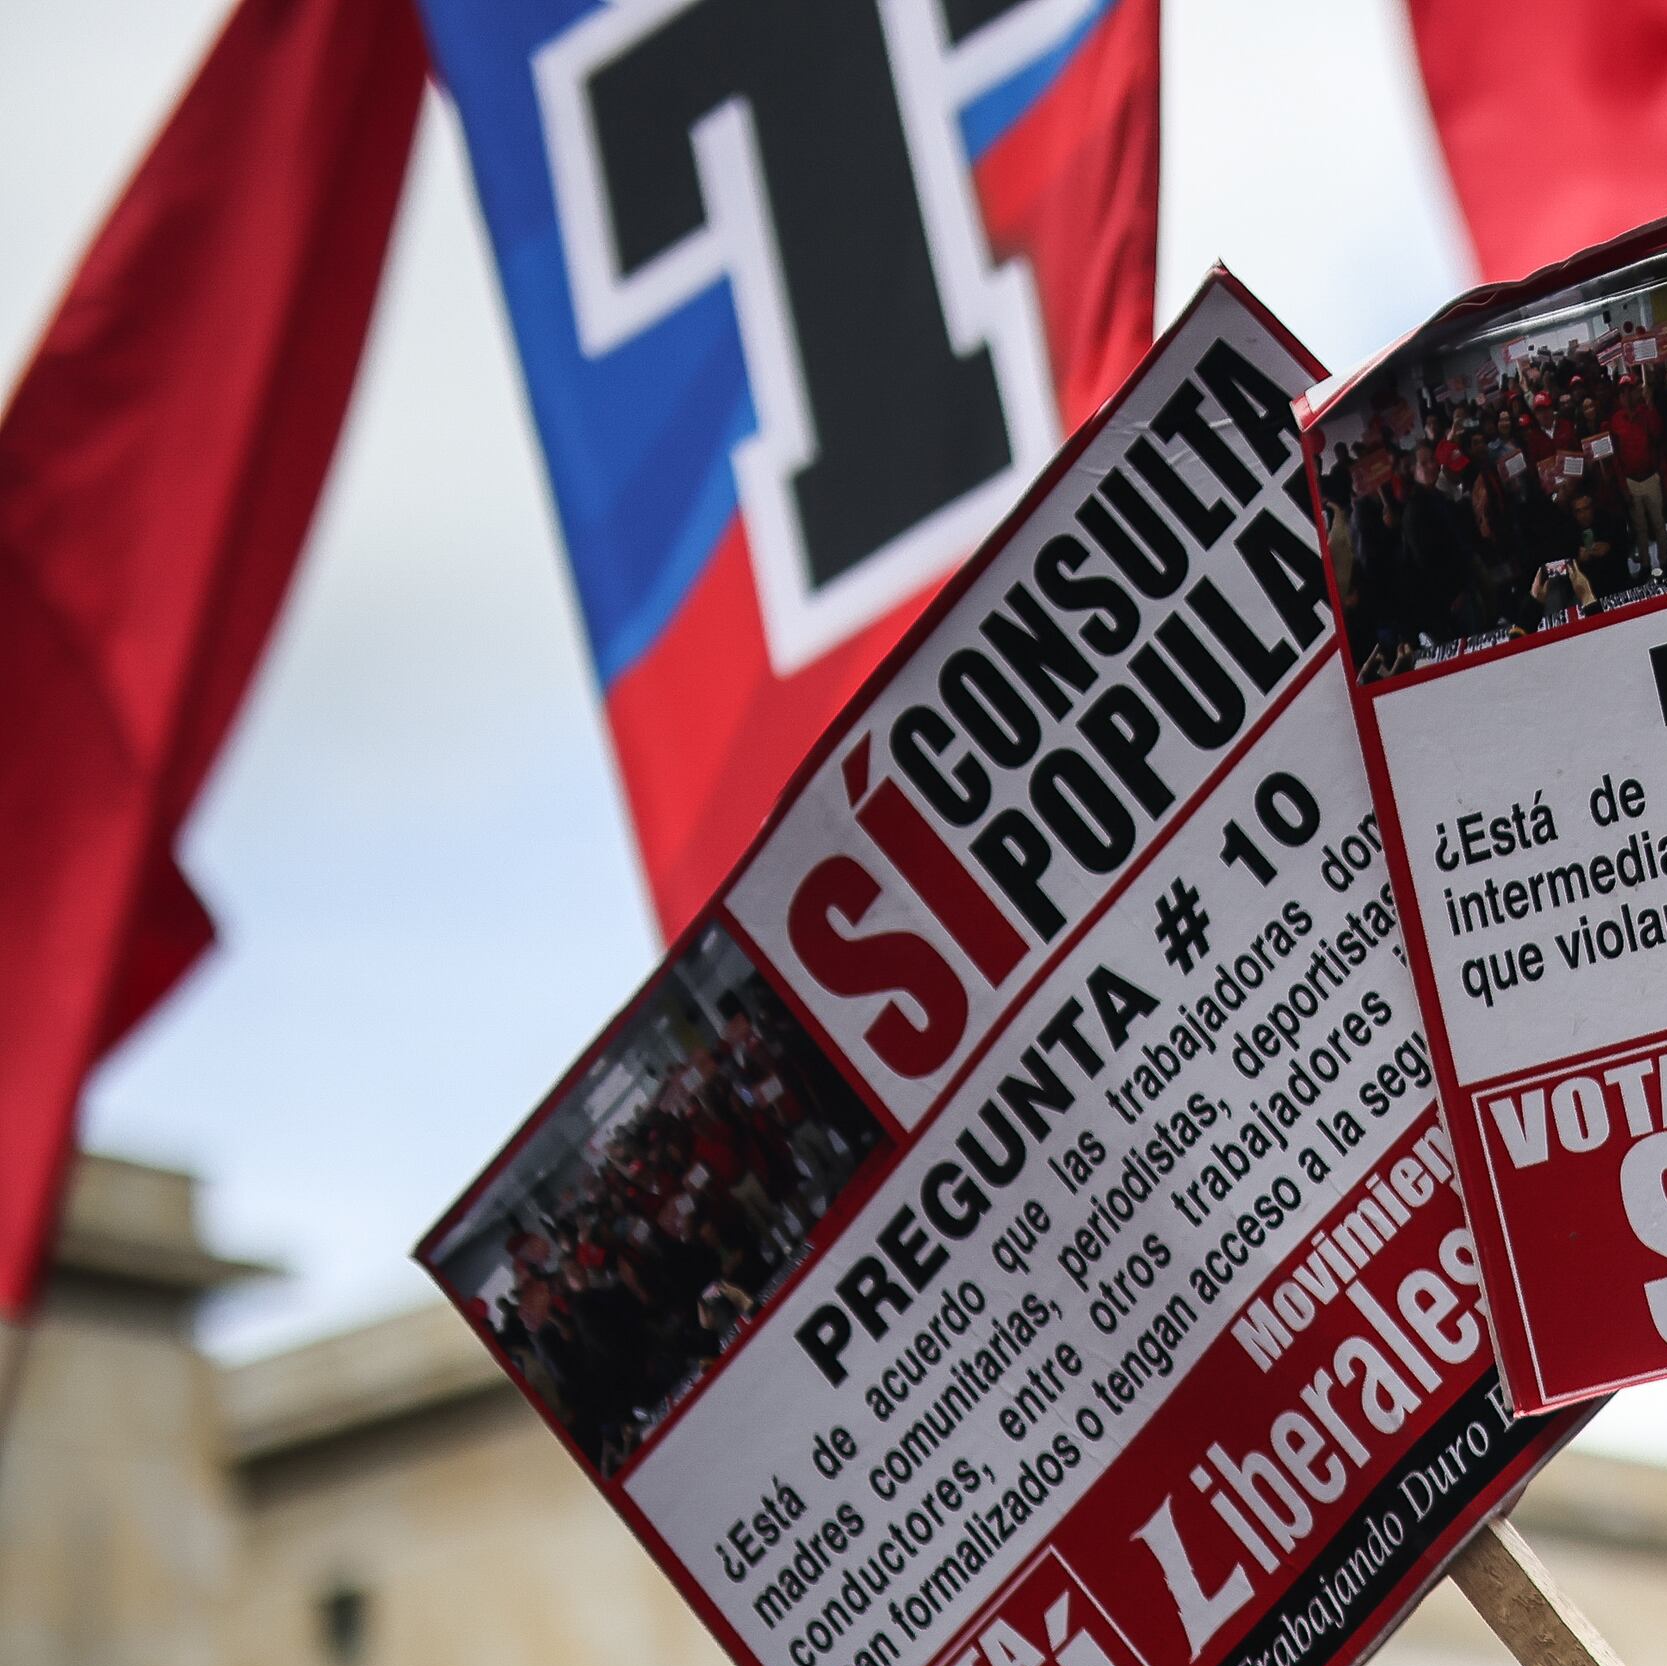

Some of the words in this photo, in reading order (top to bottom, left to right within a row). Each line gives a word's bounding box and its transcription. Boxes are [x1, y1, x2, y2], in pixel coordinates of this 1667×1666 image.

[889, 336, 1296, 829] CONSULTA
[967, 476, 1327, 945] POPULA
[787, 729, 1029, 1077] SÍ
[1435, 789, 1559, 873] ¿Está
[1589, 773, 1646, 827] de
[1461, 942, 1545, 1008] que
[715, 1474, 808, 1583] ¿Está
[812, 1427, 858, 1480] de
[865, 1280, 986, 1422] acuerdo
[991, 1199, 1051, 1275] que
[1047, 1130, 1107, 1196] las
[1104, 901, 1313, 1125] trabajadoras
[793, 964, 1161, 1389] PREGUNTA
[1155, 876, 1211, 976] #
[1219, 771, 1321, 887] 10
[999, 1342, 1083, 1441] entre
[1089, 1232, 1172, 1335] otros
[1170, 991, 1393, 1228] trabajadores
[1230, 1108, 1462, 1374] Movimien
[752, 1503, 865, 1630] madres
[869, 1293, 1063, 1501] comunitarias,
[1057, 1093, 1232, 1292] periodistas,
[888, 1434, 1082, 1642] formalizados
[1075, 1407, 1105, 1442] o
[1091, 1294, 1199, 1416] tengan
[1189, 1176, 1302, 1305] acceso
[1298, 1147, 1332, 1184] a
[1316, 1110, 1367, 1157] la
[1399, 1421, 1489, 1522] Duro
